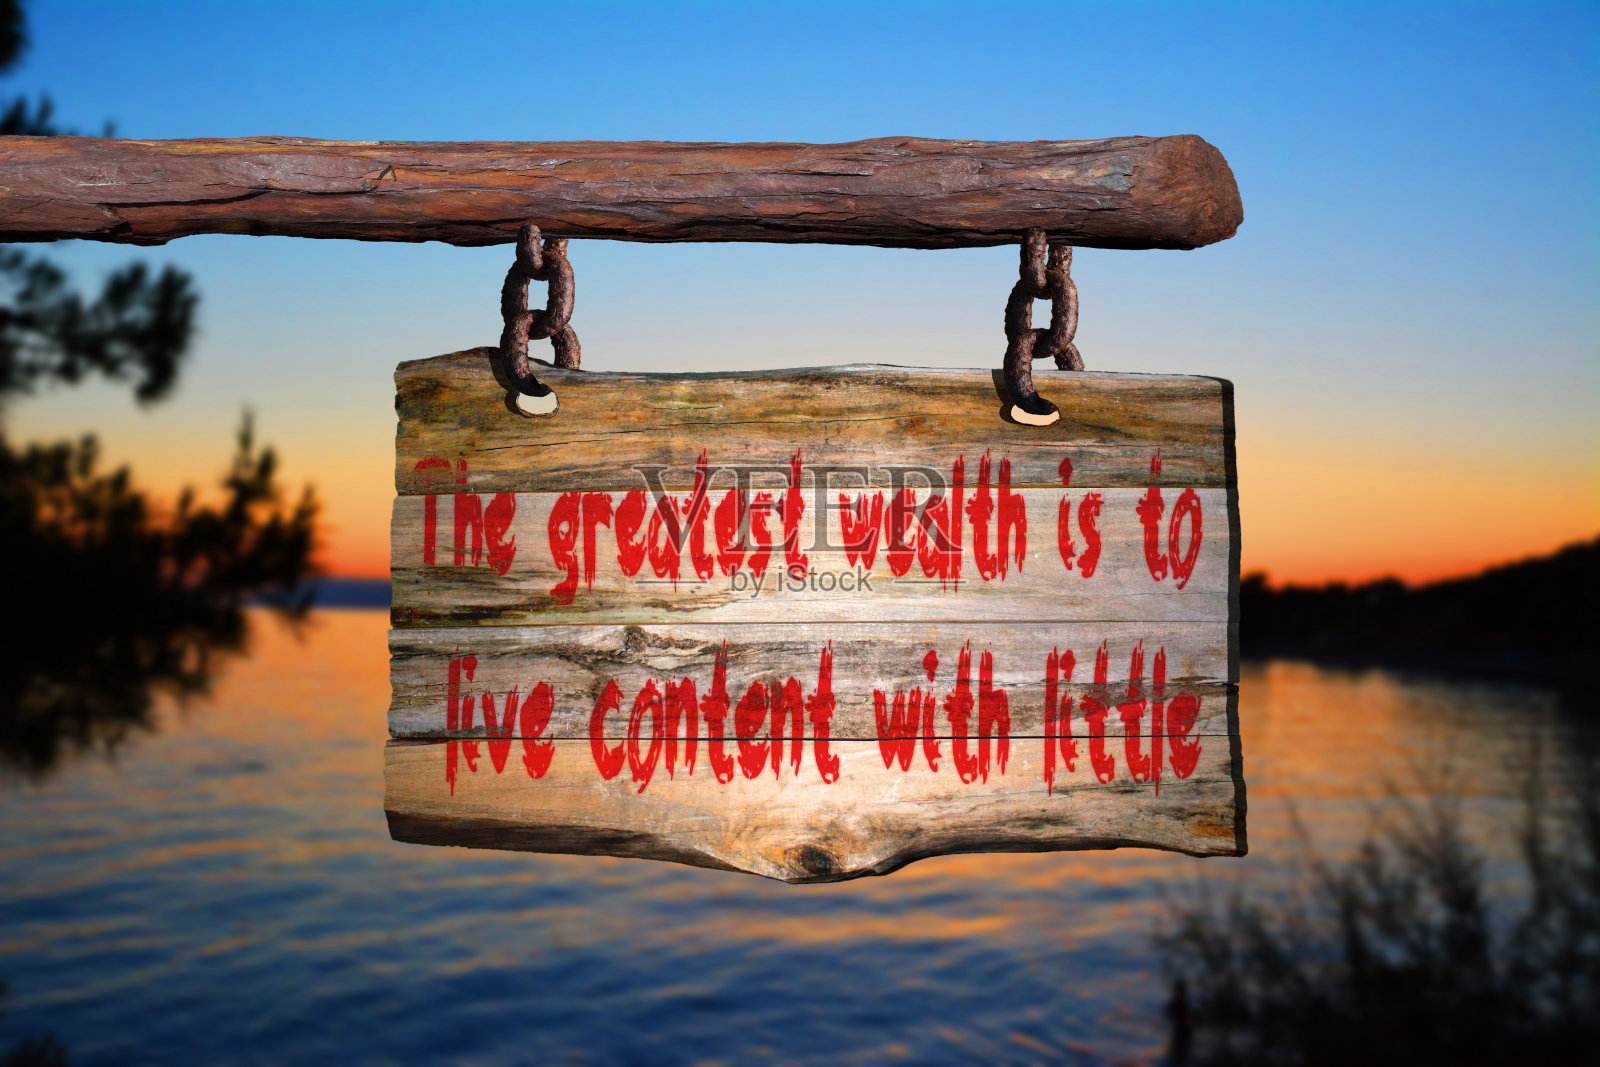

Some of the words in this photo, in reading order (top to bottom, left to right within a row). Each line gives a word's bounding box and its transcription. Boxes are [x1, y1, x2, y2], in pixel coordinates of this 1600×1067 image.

[415, 455, 517, 576] The
[548, 448, 808, 606] greatest
[839, 448, 1027, 592] wealth
[1058, 458, 1104, 578] is
[1136, 448, 1203, 590] to
[446, 648, 555, 797] live
[589, 639, 840, 794] content
[873, 639, 1010, 784] with
[1044, 639, 1202, 797] little
